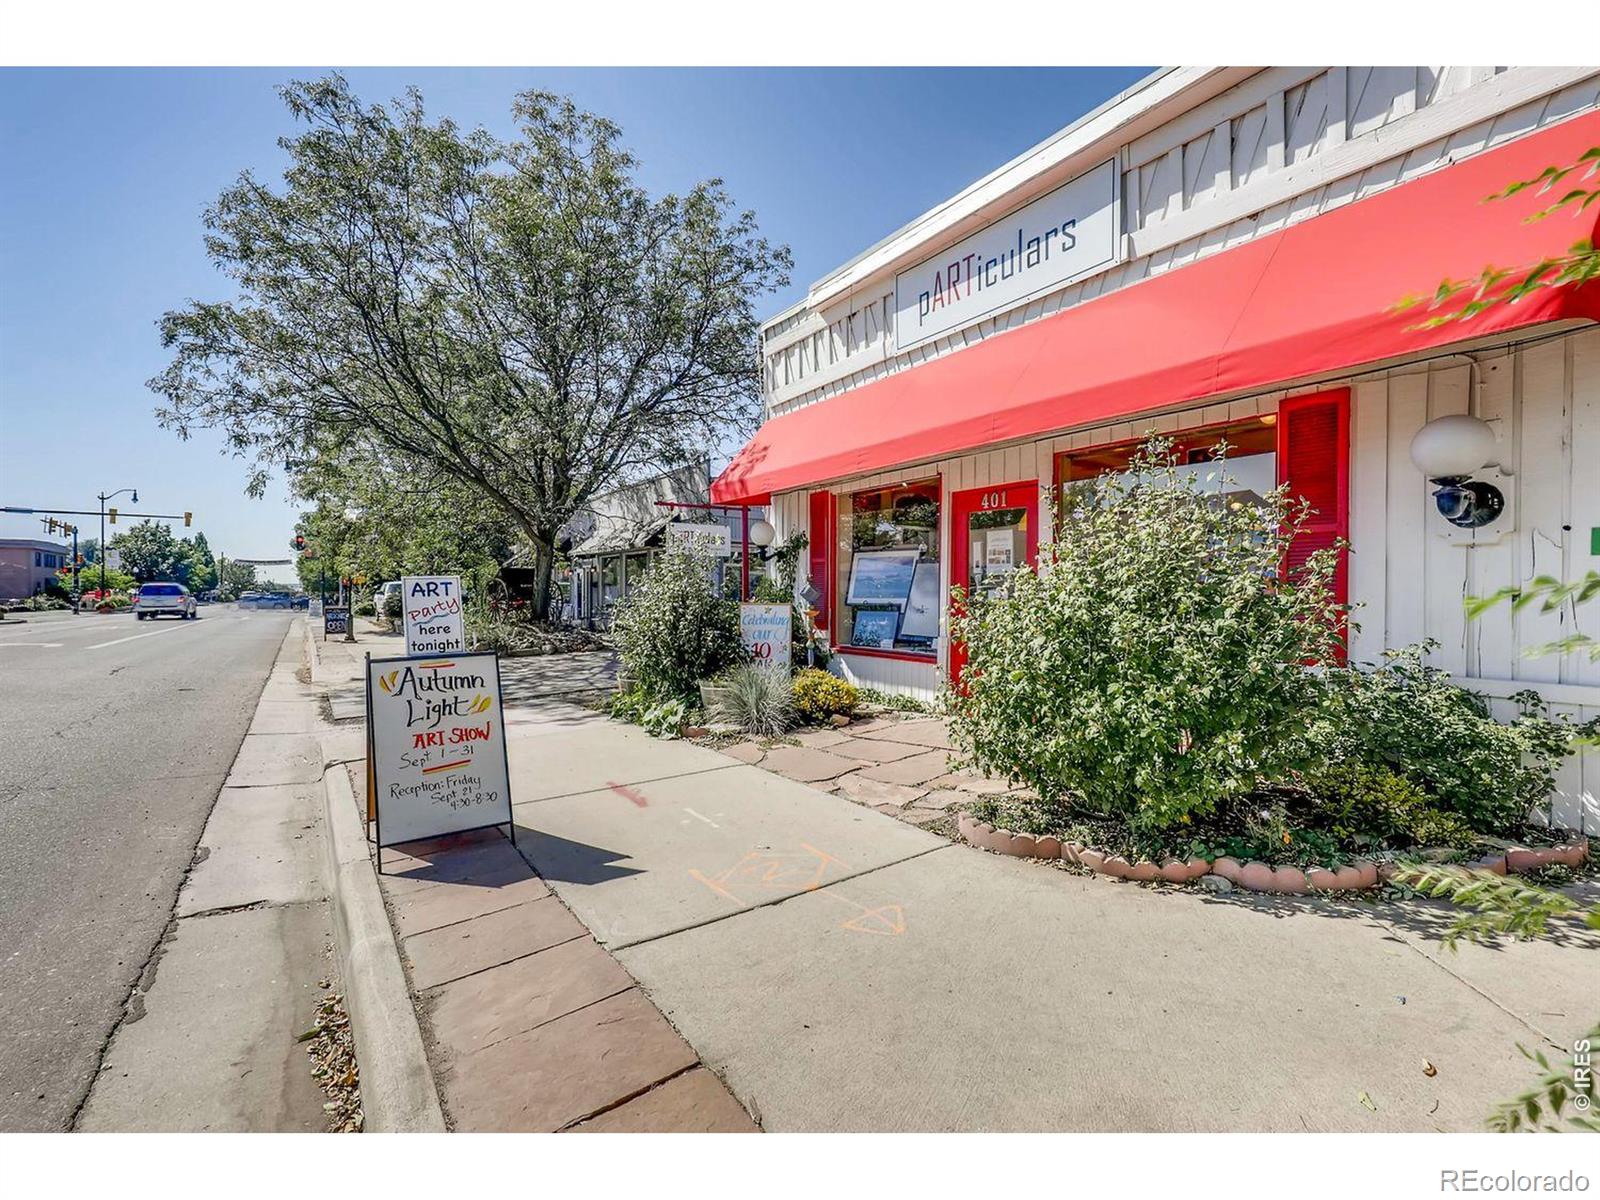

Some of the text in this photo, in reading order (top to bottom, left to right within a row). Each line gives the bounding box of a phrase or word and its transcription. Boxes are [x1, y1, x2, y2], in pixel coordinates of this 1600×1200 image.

[919, 218, 1077, 327] pARTiculars
[981, 491, 1008, 508] 401
[411, 581, 453, 598] ART
[419, 624, 451, 635] here
[411, 638, 460, 653] tonight
[751, 642, 771, 658] 10
[391, 666, 486, 700] Autumn
[406, 696, 470, 729] Light
[413, 721, 491, 749] ART SHOW
[461, 745, 474, 756] 31
[446, 774, 481, 790] Friday
